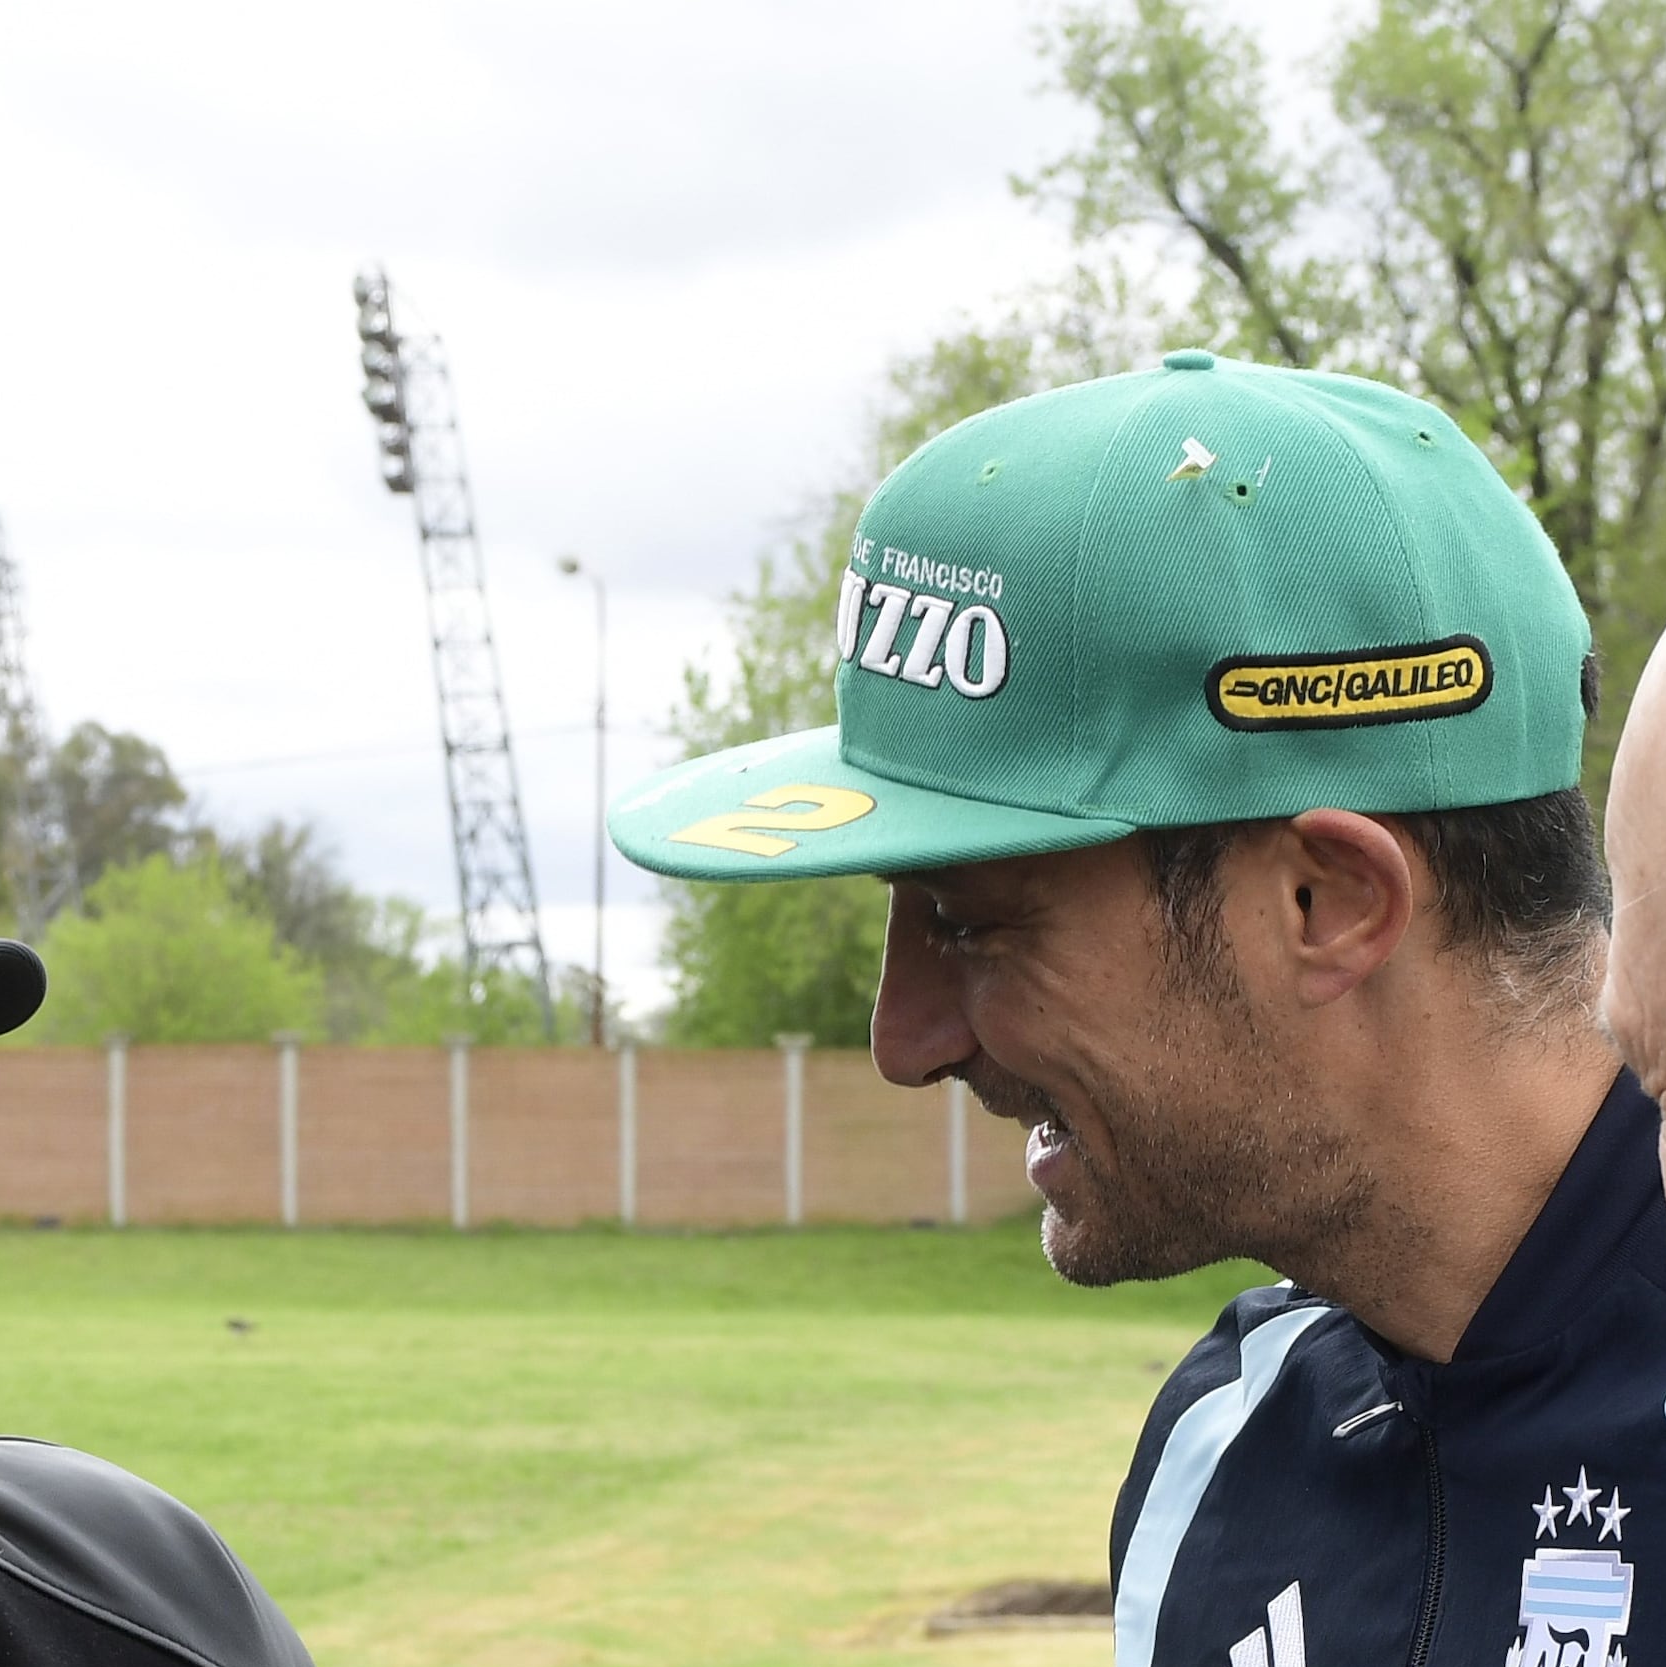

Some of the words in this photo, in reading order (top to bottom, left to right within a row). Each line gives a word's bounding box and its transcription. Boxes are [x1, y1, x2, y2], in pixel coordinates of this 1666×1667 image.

[854, 531, 876, 565] DE
[882, 547, 1004, 599] FRANCISCO
[1258, 658, 1474, 707] GNC/GALILEO
[667, 784, 878, 858] 2
